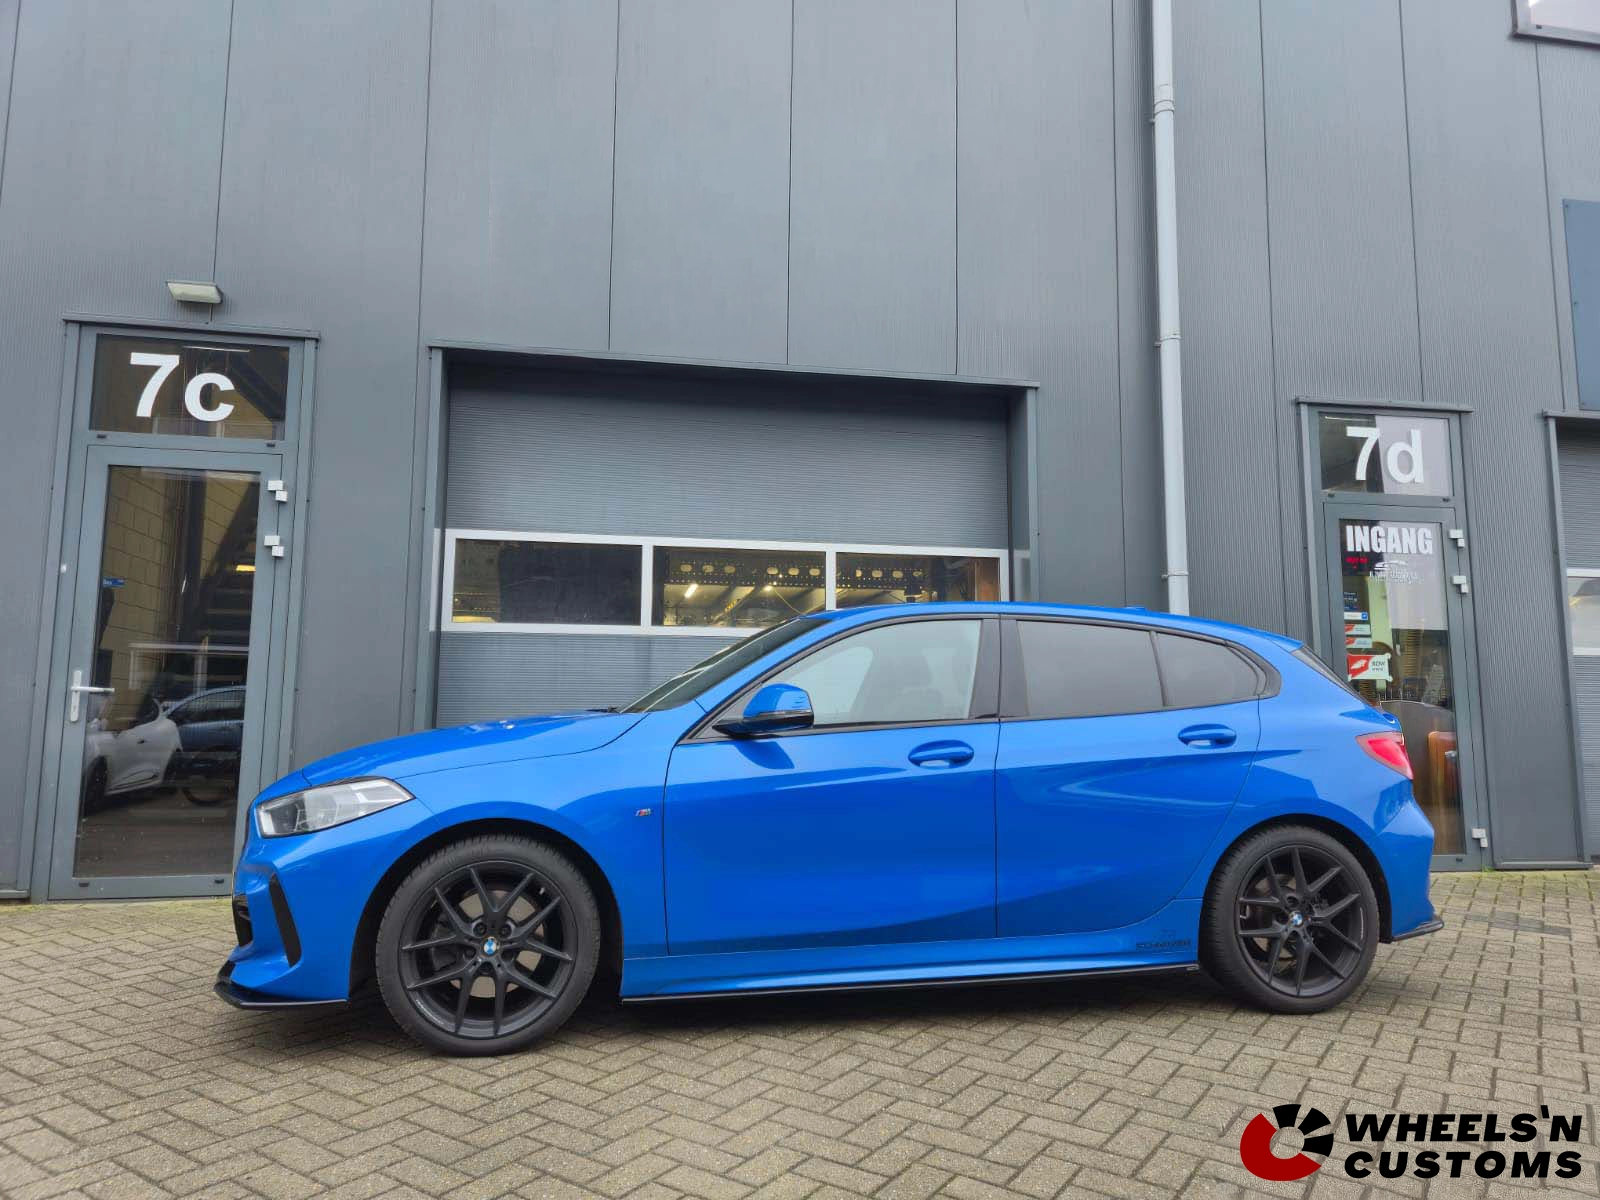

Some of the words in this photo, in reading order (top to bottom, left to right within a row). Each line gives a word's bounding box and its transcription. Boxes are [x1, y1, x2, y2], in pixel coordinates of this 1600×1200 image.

[130, 352, 235, 422] 7c
[1346, 426, 1424, 484] 7d
[1345, 525, 1433, 555] INGANG
